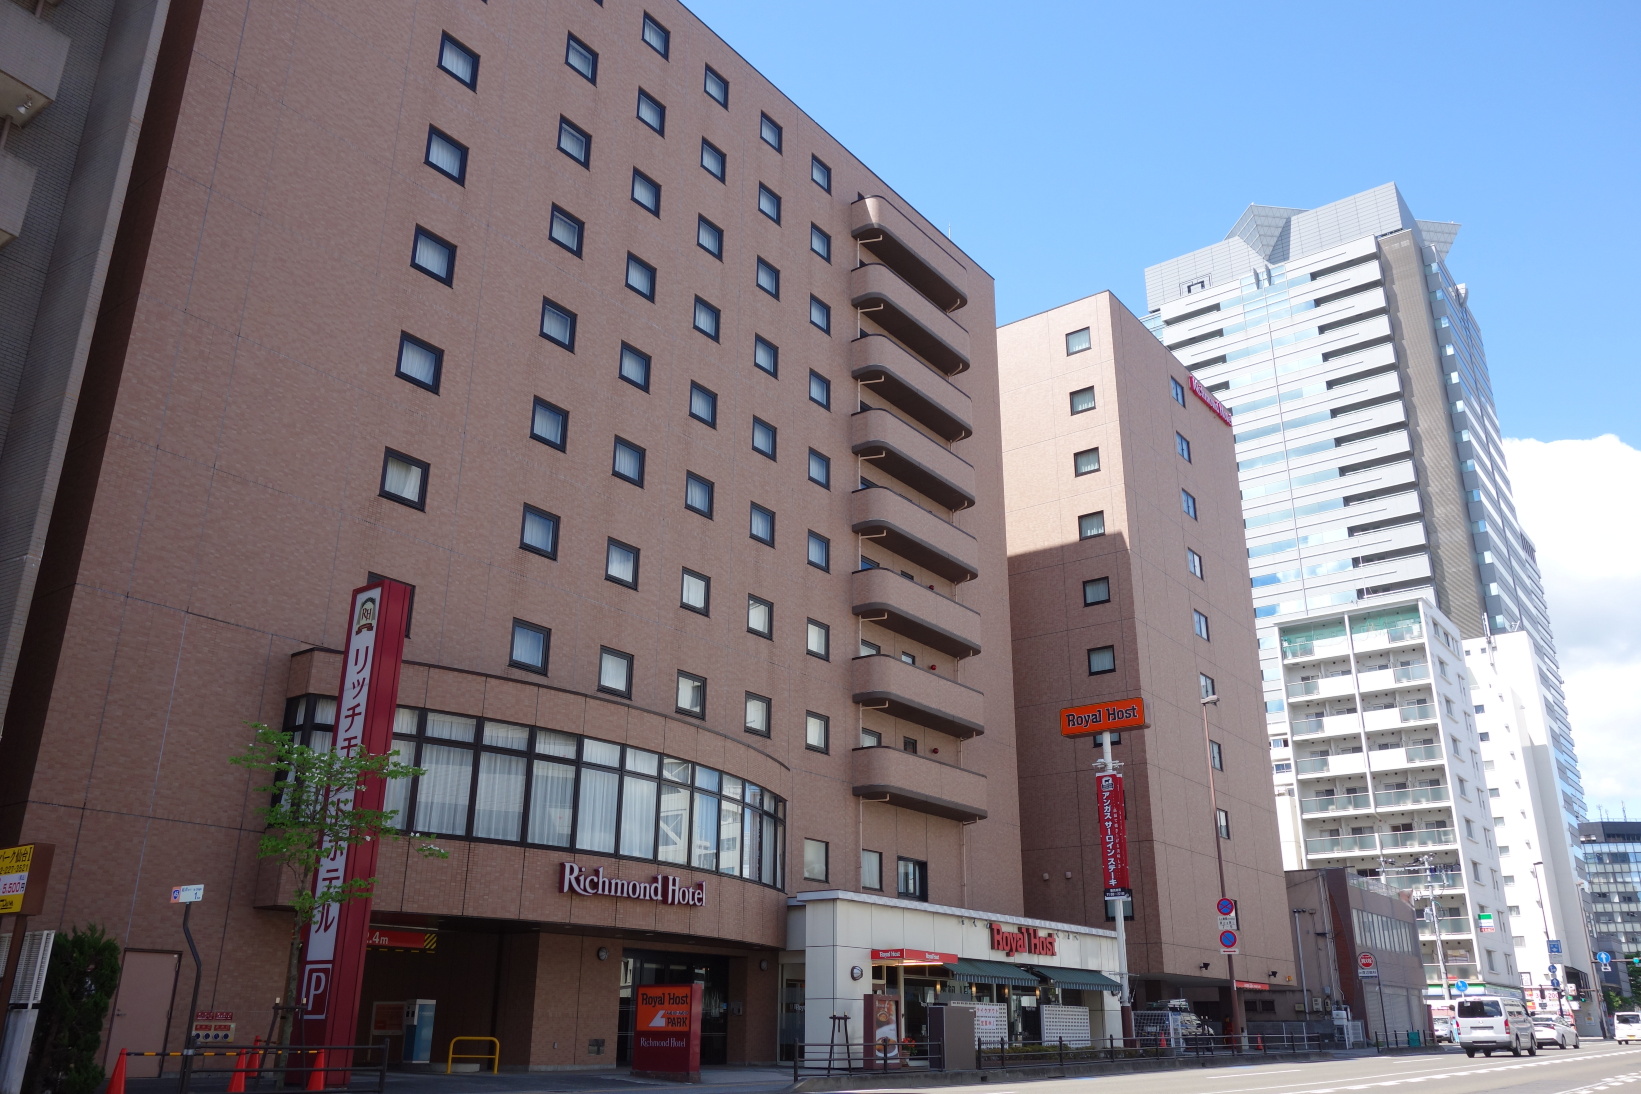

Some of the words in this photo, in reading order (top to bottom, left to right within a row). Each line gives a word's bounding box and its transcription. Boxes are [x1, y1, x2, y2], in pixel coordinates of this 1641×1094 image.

[361, 607, 372, 621] RH
[1066, 709, 1102, 728] Royal
[1105, 704, 1138, 722] Host
[561, 862, 663, 901] Richmond
[667, 874, 706, 906] Hotel
[366, 931, 389, 945] .4m
[990, 923, 1028, 957] Royal
[1028, 927, 1057, 956] Host
[308, 972, 326, 1011] P
[641, 992, 665, 1007] Royal
[668, 992, 689, 1005] Host
[667, 1016, 688, 1028] PARK
[640, 1037, 670, 1048] Richmond
[670, 1037, 686, 1048] Hotel
